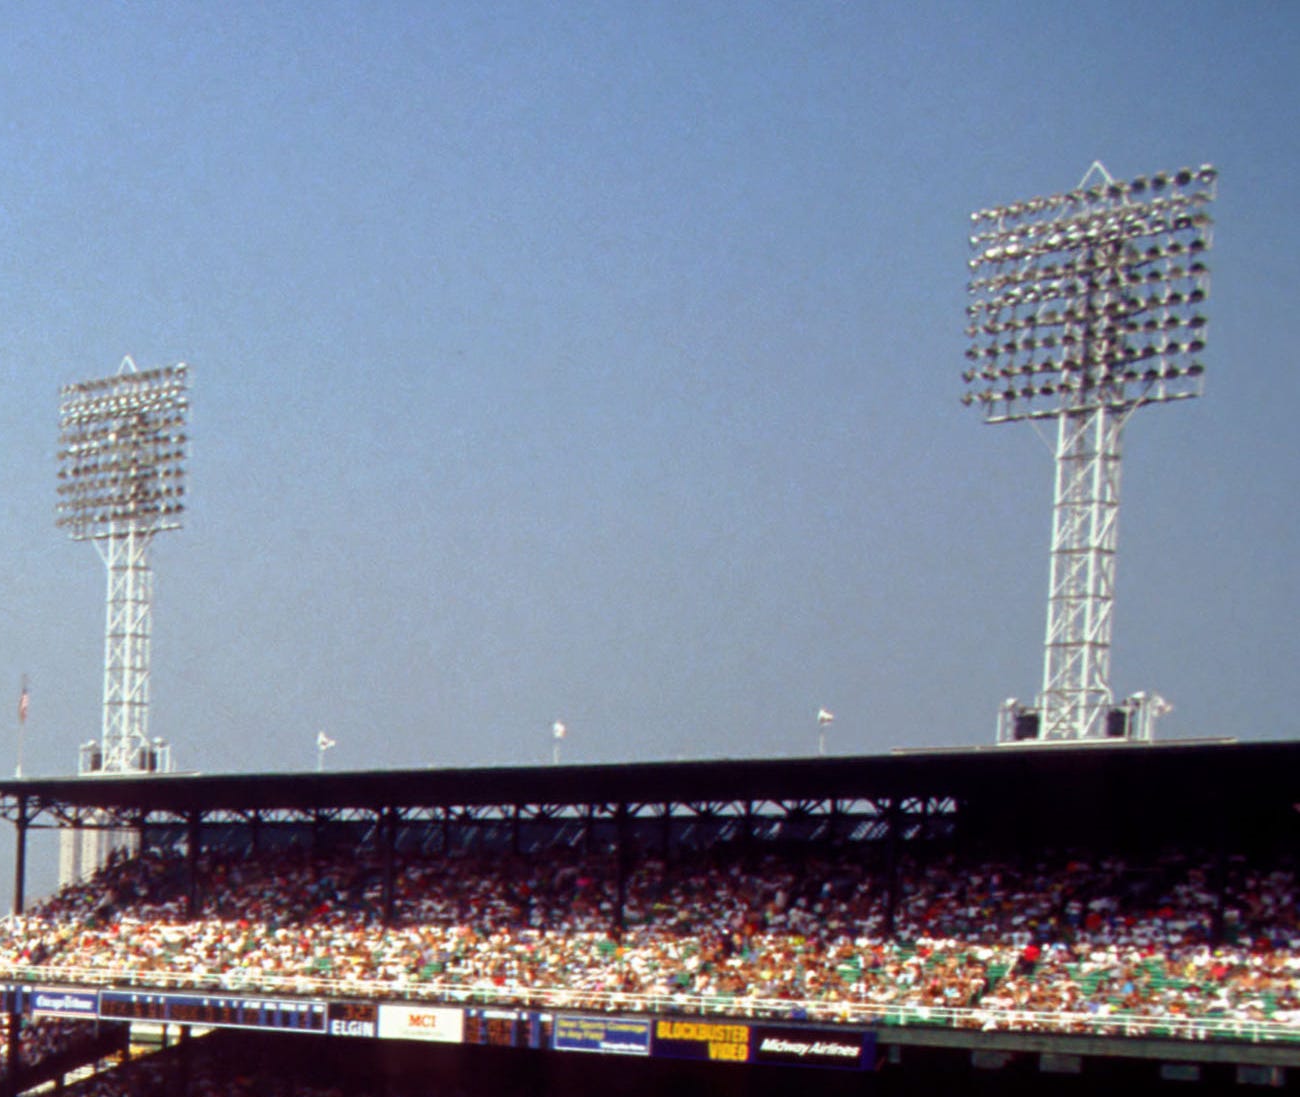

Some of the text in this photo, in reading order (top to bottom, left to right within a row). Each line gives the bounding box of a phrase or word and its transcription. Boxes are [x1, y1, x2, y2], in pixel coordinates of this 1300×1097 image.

[331, 1019, 375, 1037] ELGIN
[408, 1014, 437, 1028] MCI
[657, 1021, 750, 1043] BLOCKBUSTER
[708, 1042, 749, 1062] VIDEO
[760, 1038, 860, 1057] Midway Airlines
